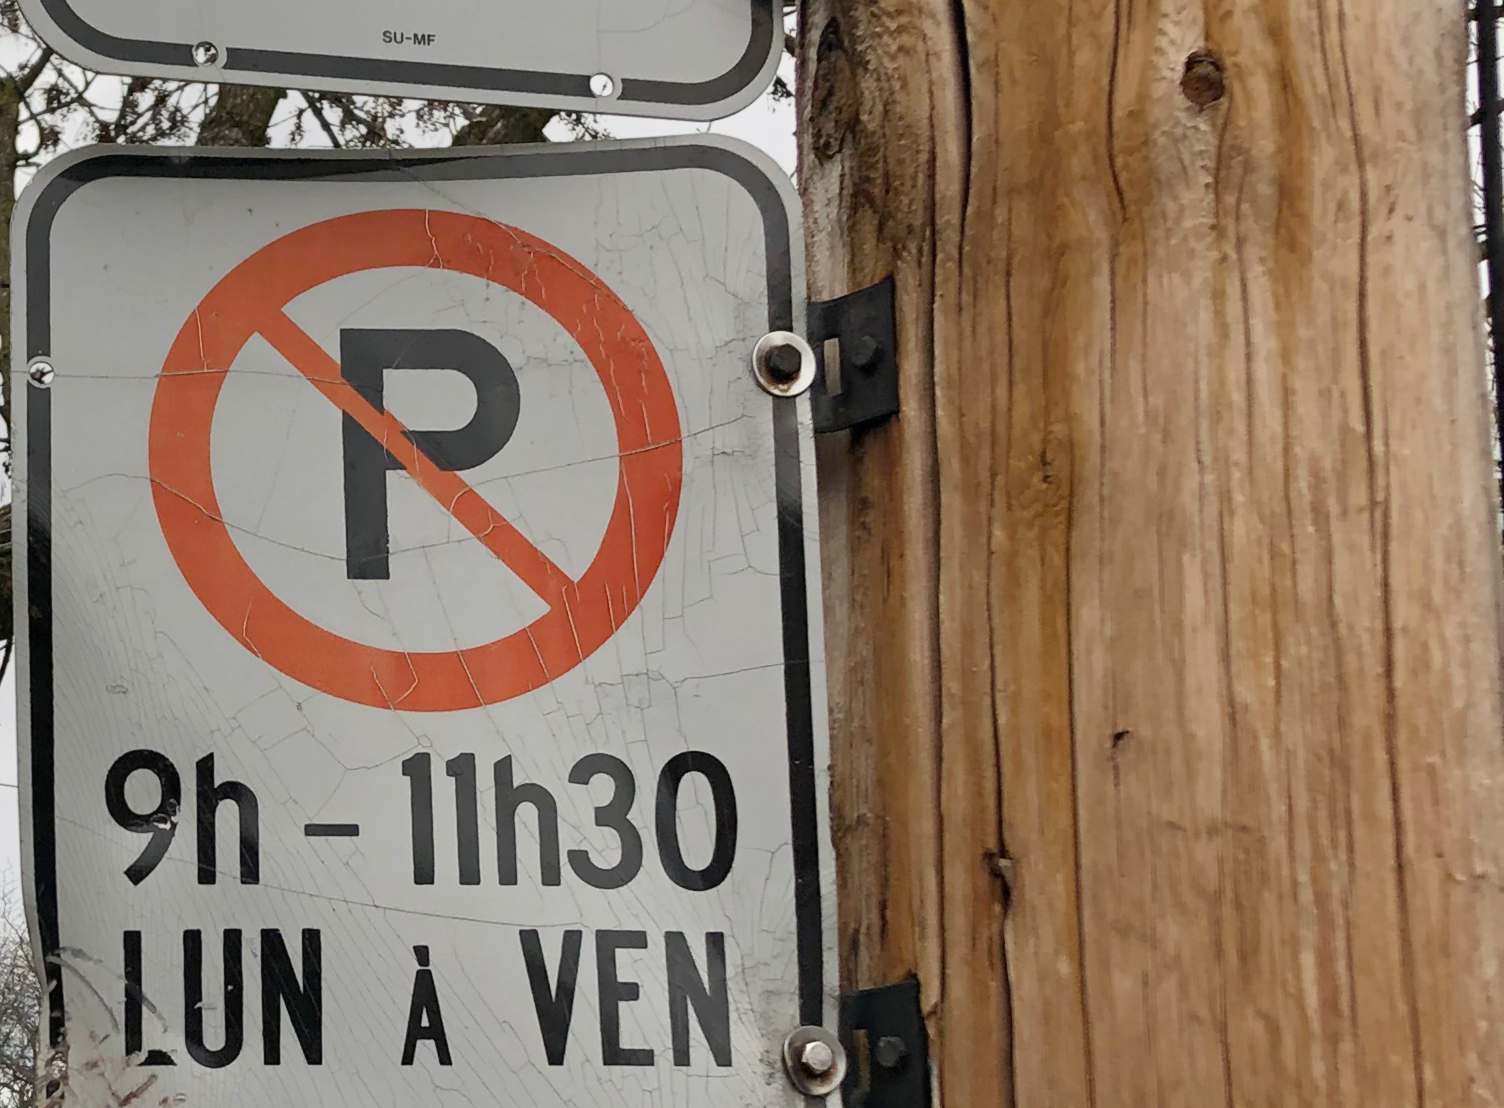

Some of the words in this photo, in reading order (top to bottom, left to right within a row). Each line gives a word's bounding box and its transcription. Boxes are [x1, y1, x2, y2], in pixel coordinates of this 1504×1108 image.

[382, 30, 436, 46] SU-MF
[340, 328, 520, 580] P
[105, 749, 259, 886] 9h
[402, 751, 737, 891] 11h30
[124, 928, 322, 1068] LUN
[401, 945, 452, 1066] À
[519, 929, 732, 1067] VEN
